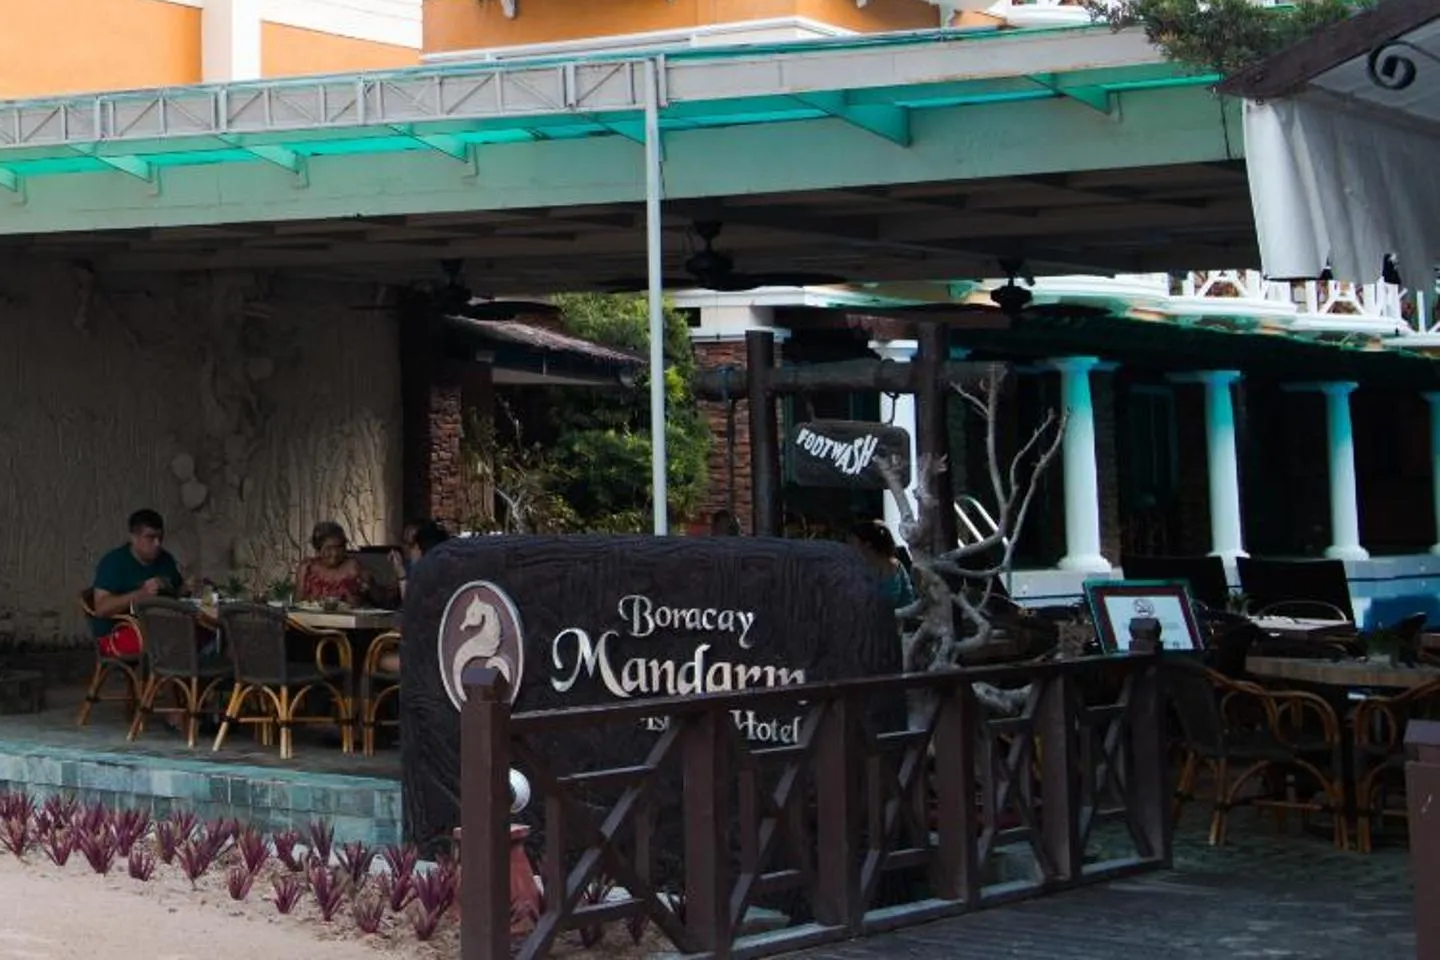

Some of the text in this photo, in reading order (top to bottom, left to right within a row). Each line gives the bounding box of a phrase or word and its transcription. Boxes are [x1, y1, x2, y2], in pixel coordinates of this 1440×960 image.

[796, 427, 878, 475] FOOTWASH
[618, 594, 754, 649] Boracay
[729, 709, 802, 743] Hotel
